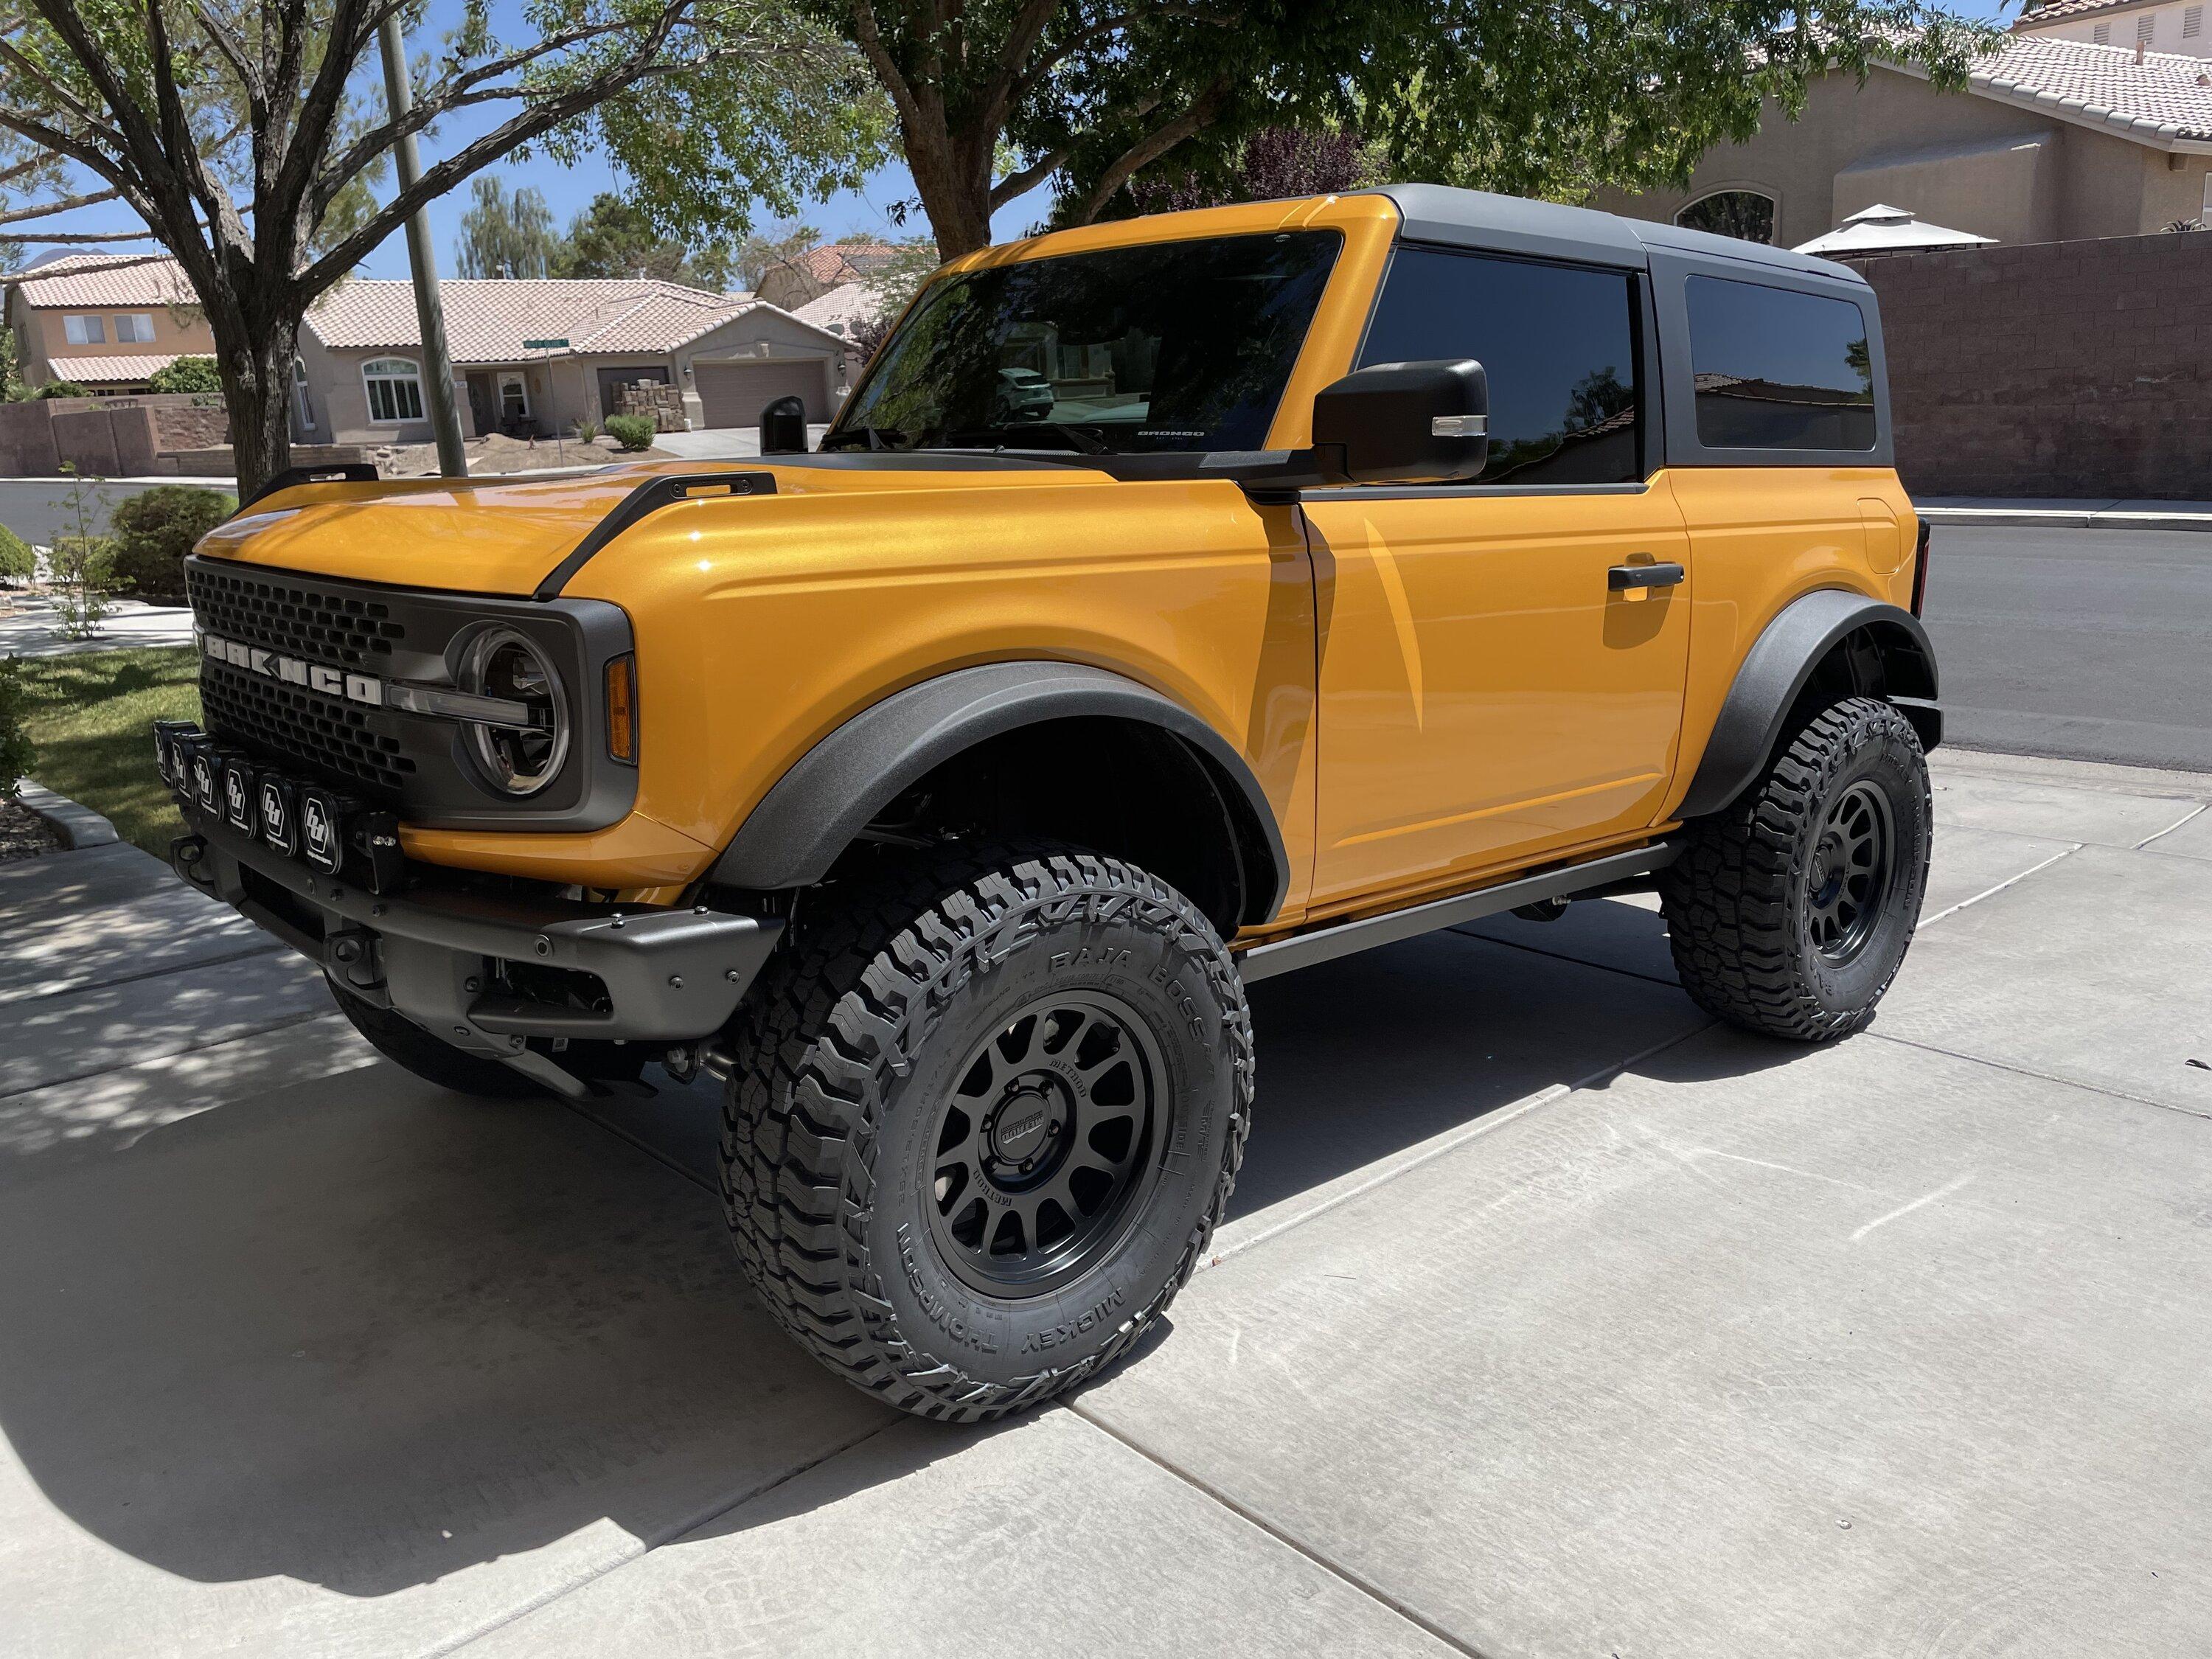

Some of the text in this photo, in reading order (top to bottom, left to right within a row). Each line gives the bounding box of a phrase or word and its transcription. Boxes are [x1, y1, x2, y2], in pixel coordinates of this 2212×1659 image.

[265, 792, 280, 827] bd
[306, 807, 324, 843] bd
[1048, 947, 1133, 973] BAJA
[1148, 964, 1208, 1042] BOSS
[1049, 1059, 1087, 1098] METHOD
[1001, 1116, 1045, 1142] METHOD
[973, 1168, 1012, 1207] METHOD
[897, 1221, 1127, 1355] MICKEY THOMPSON
